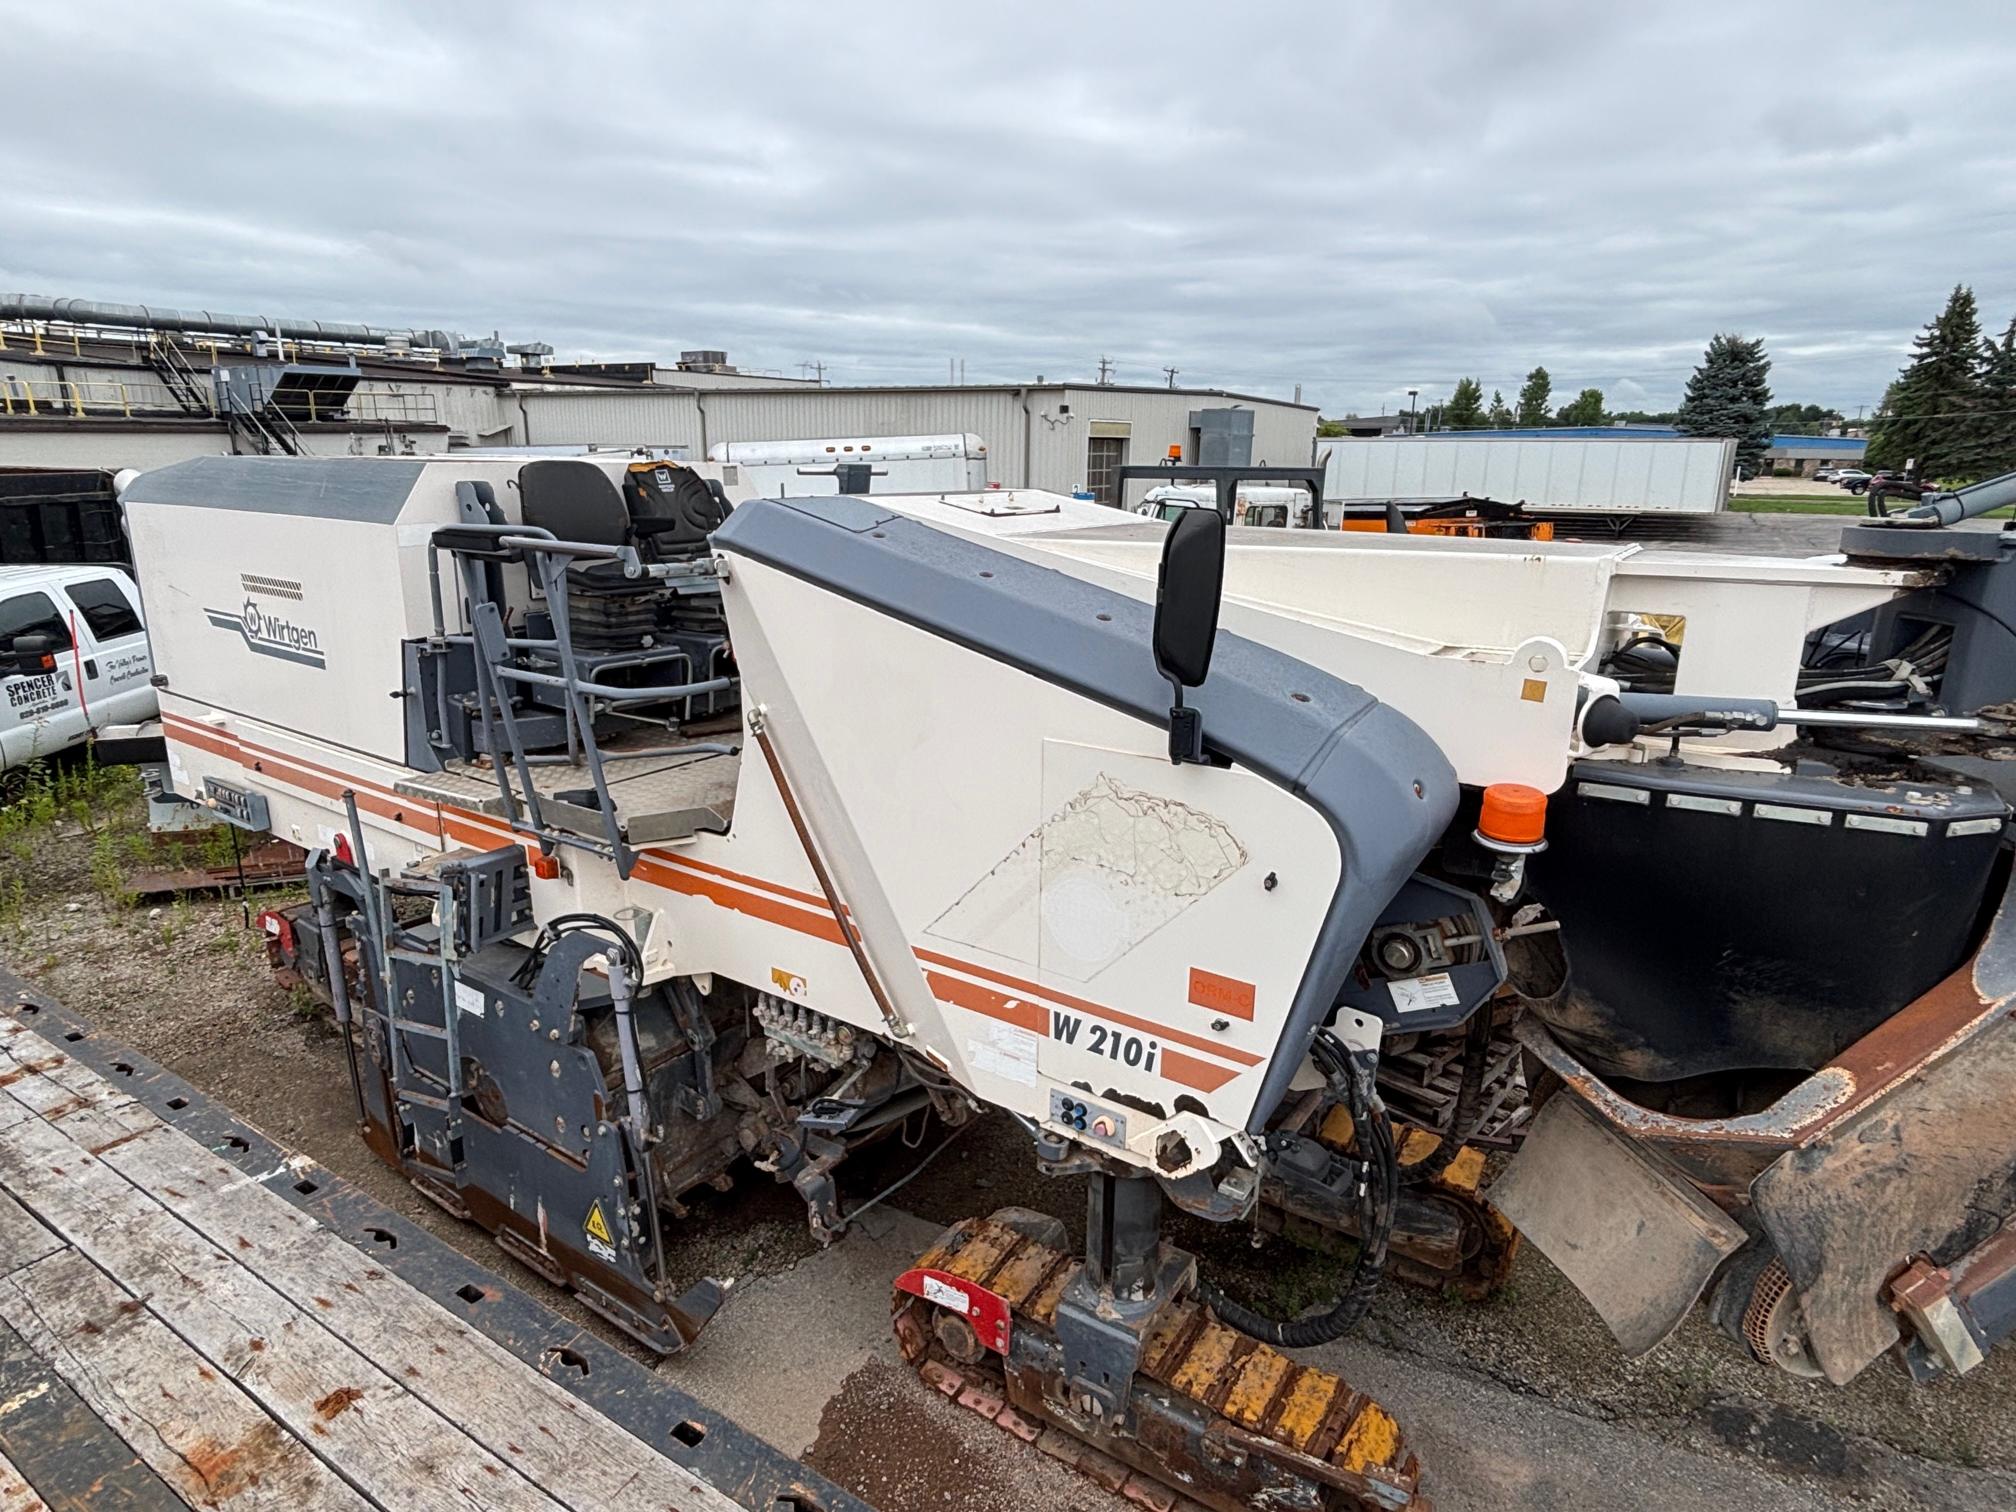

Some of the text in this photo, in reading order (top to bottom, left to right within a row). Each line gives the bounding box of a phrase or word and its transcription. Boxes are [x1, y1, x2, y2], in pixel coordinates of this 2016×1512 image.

[263, 615, 318, 652] Wirtgen
[6, 674, 55, 697] SPENCER
[10, 686, 58, 708] CONCRETE
[1053, 1010, 1082, 1045] W
[1086, 1024, 1157, 1073] 210i
